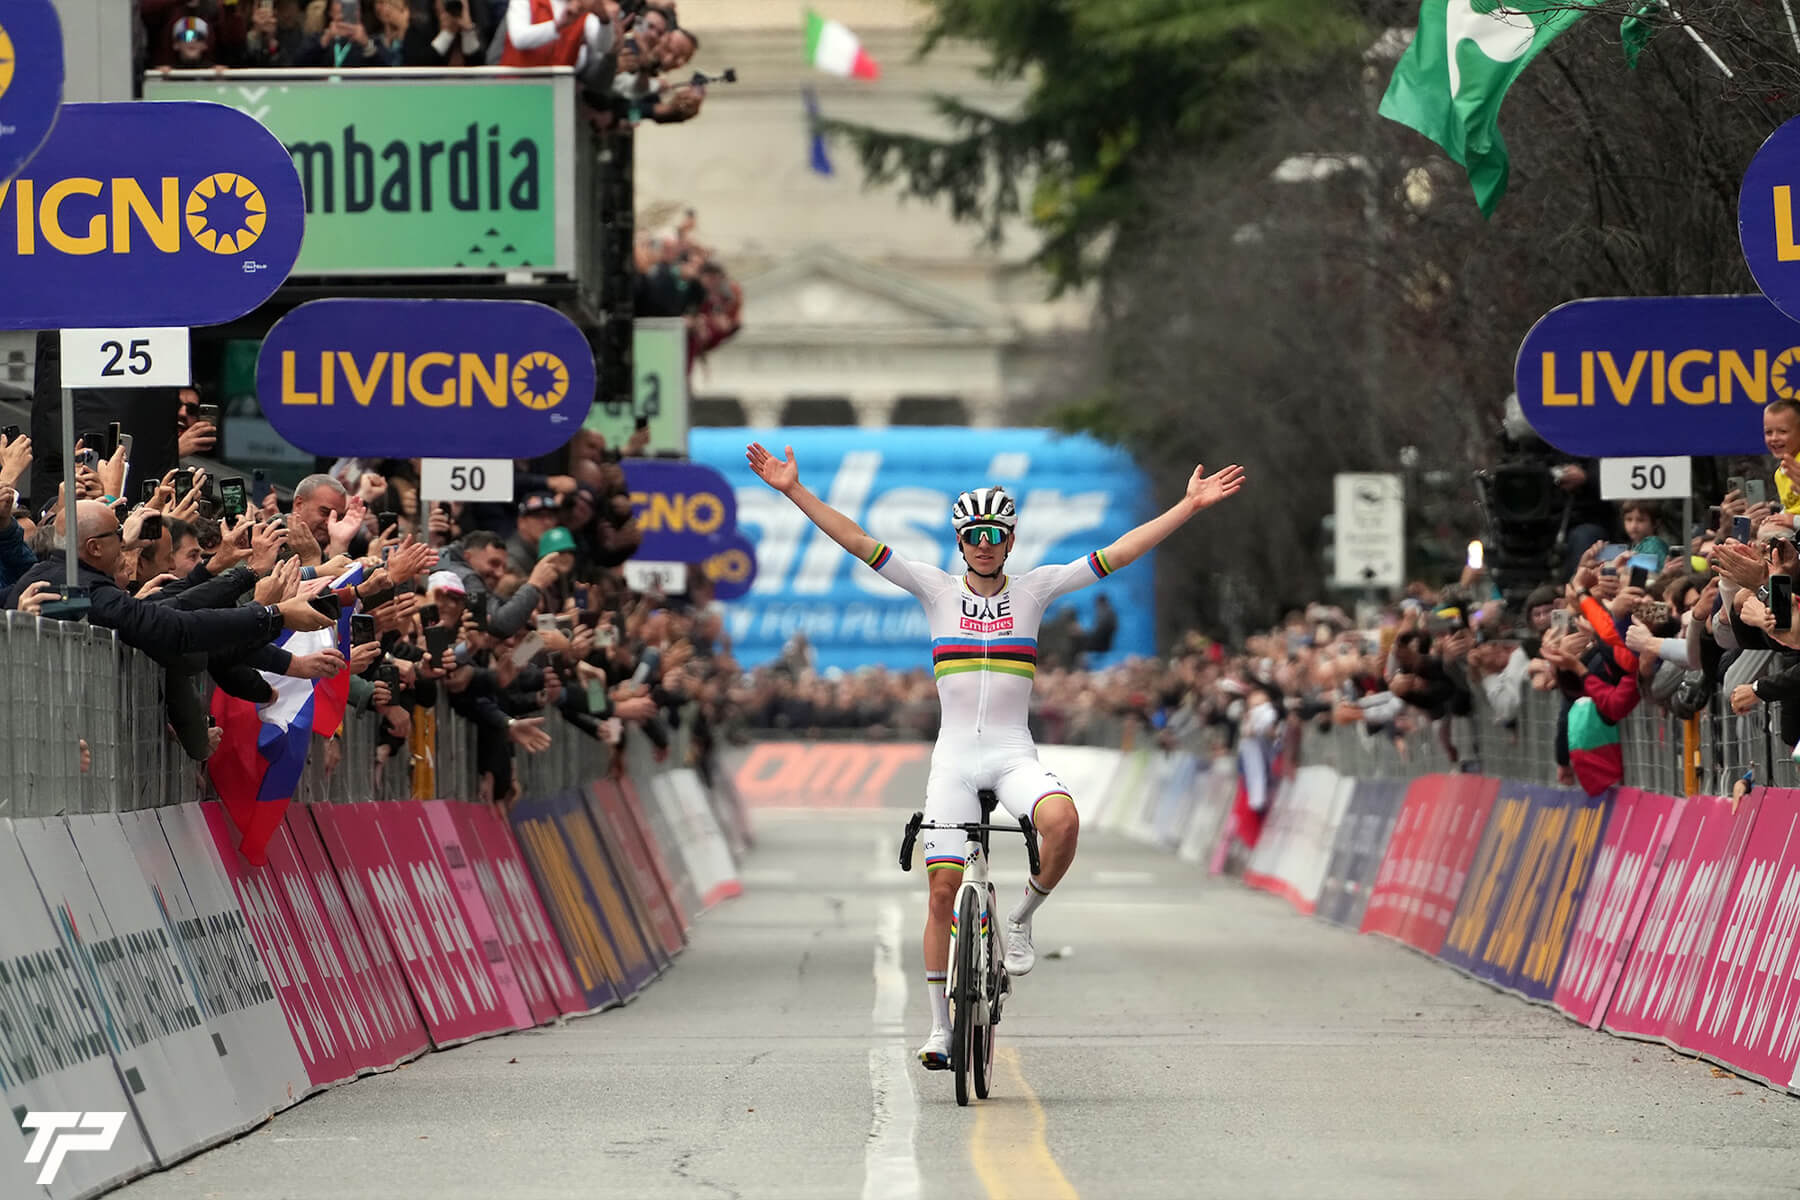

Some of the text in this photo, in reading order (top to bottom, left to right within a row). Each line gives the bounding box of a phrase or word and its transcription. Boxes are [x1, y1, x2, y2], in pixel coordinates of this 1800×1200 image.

[0, 172, 267, 255] IGNO
[100, 339, 152, 377] 25
[281, 350, 569, 409] LIVIGNO
[450, 466, 485, 491] 50
[1631, 465, 1666, 490] 50
[962, 598, 1011, 619] UAE
[962, 619, 1012, 632] Emirates
